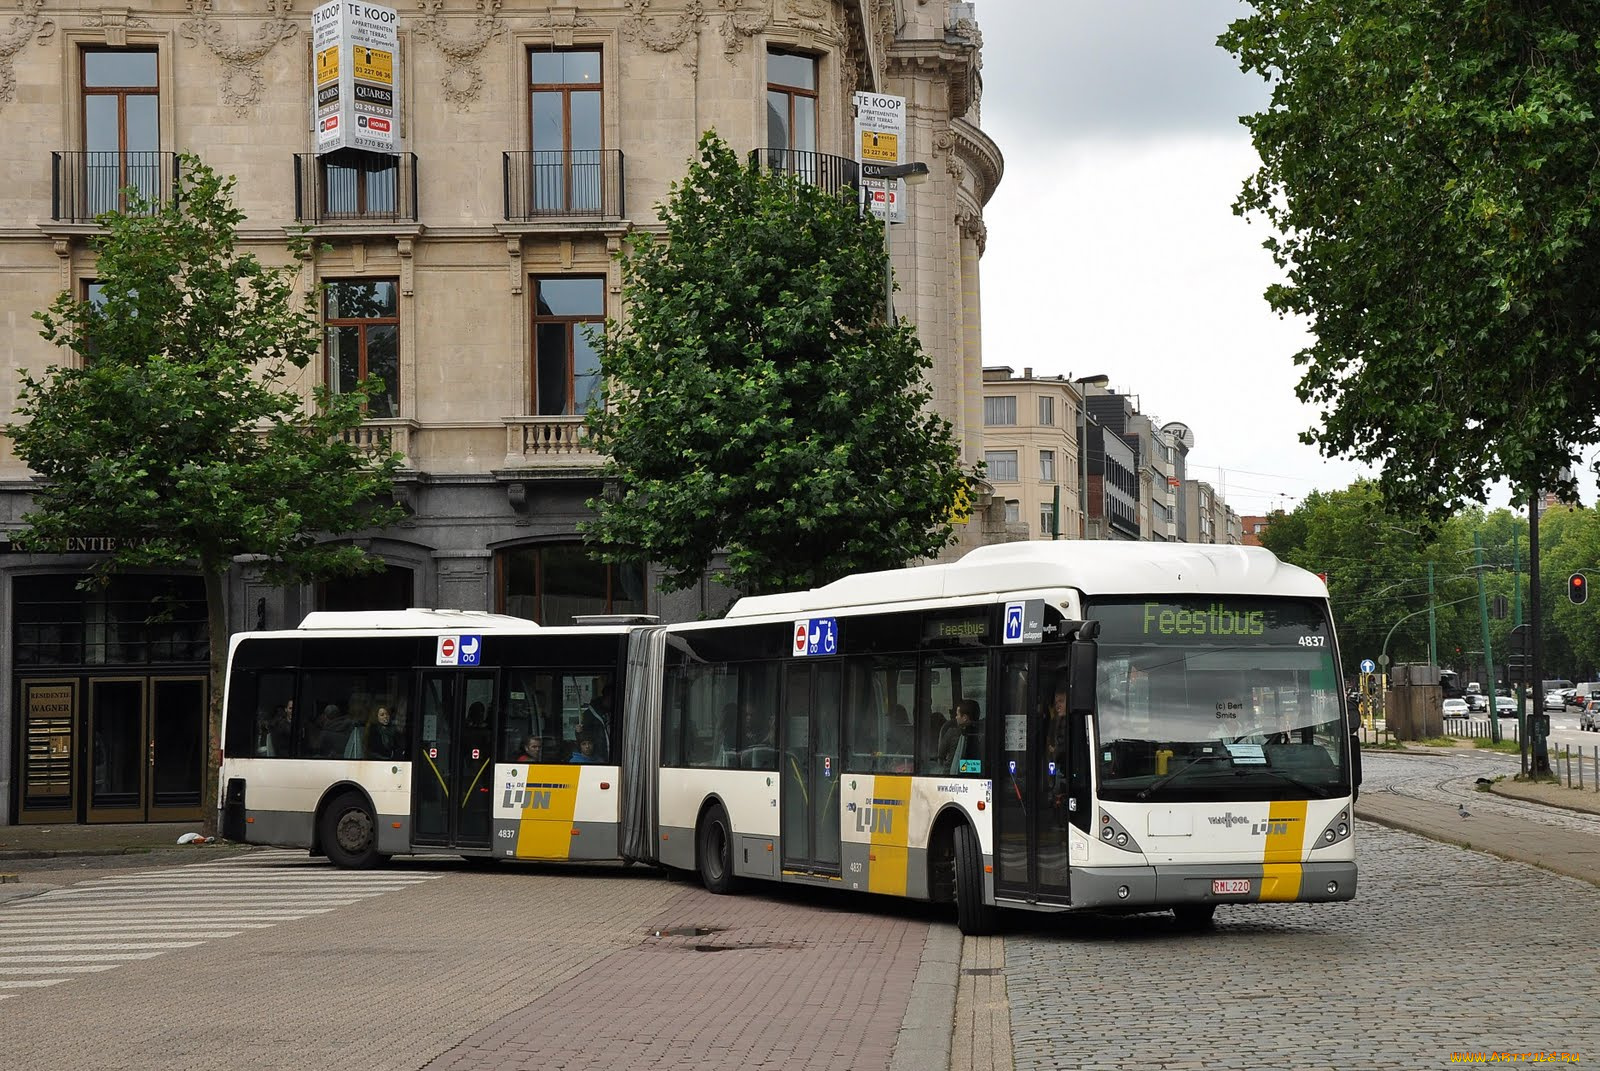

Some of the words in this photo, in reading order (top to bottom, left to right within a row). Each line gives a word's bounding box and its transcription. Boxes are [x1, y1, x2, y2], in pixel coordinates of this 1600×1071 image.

[314, 14, 320, 24] TE
[322, 4, 340, 21] KOOP
[348, 4, 360, 16] TE
[364, 9, 396, 24] KOOP
[352, 20, 393, 33] APPARTEMENTEN
[369, 30, 387, 39] TERRAS
[356, 87, 391, 101] QUARES
[858, 95, 868, 106] TE
[872, 98, 901, 110] KOOP
[370, 121, 387, 129] HOME
[1143, 602, 1264, 635] Feestbus
[940, 622, 984, 636] Feestbus
[1298, 636, 1325, 647] 4837
[32, 704, 70, 712] WAGNER
[937, 784, 968, 794] www.delijn.be
[502, 790, 551, 809] LIJN
[856, 808, 893, 834] LIJN
[498, 829, 515, 838] 4837
[1251, 824, 1288, 835] LIJN
[850, 862, 862, 872] 4837
